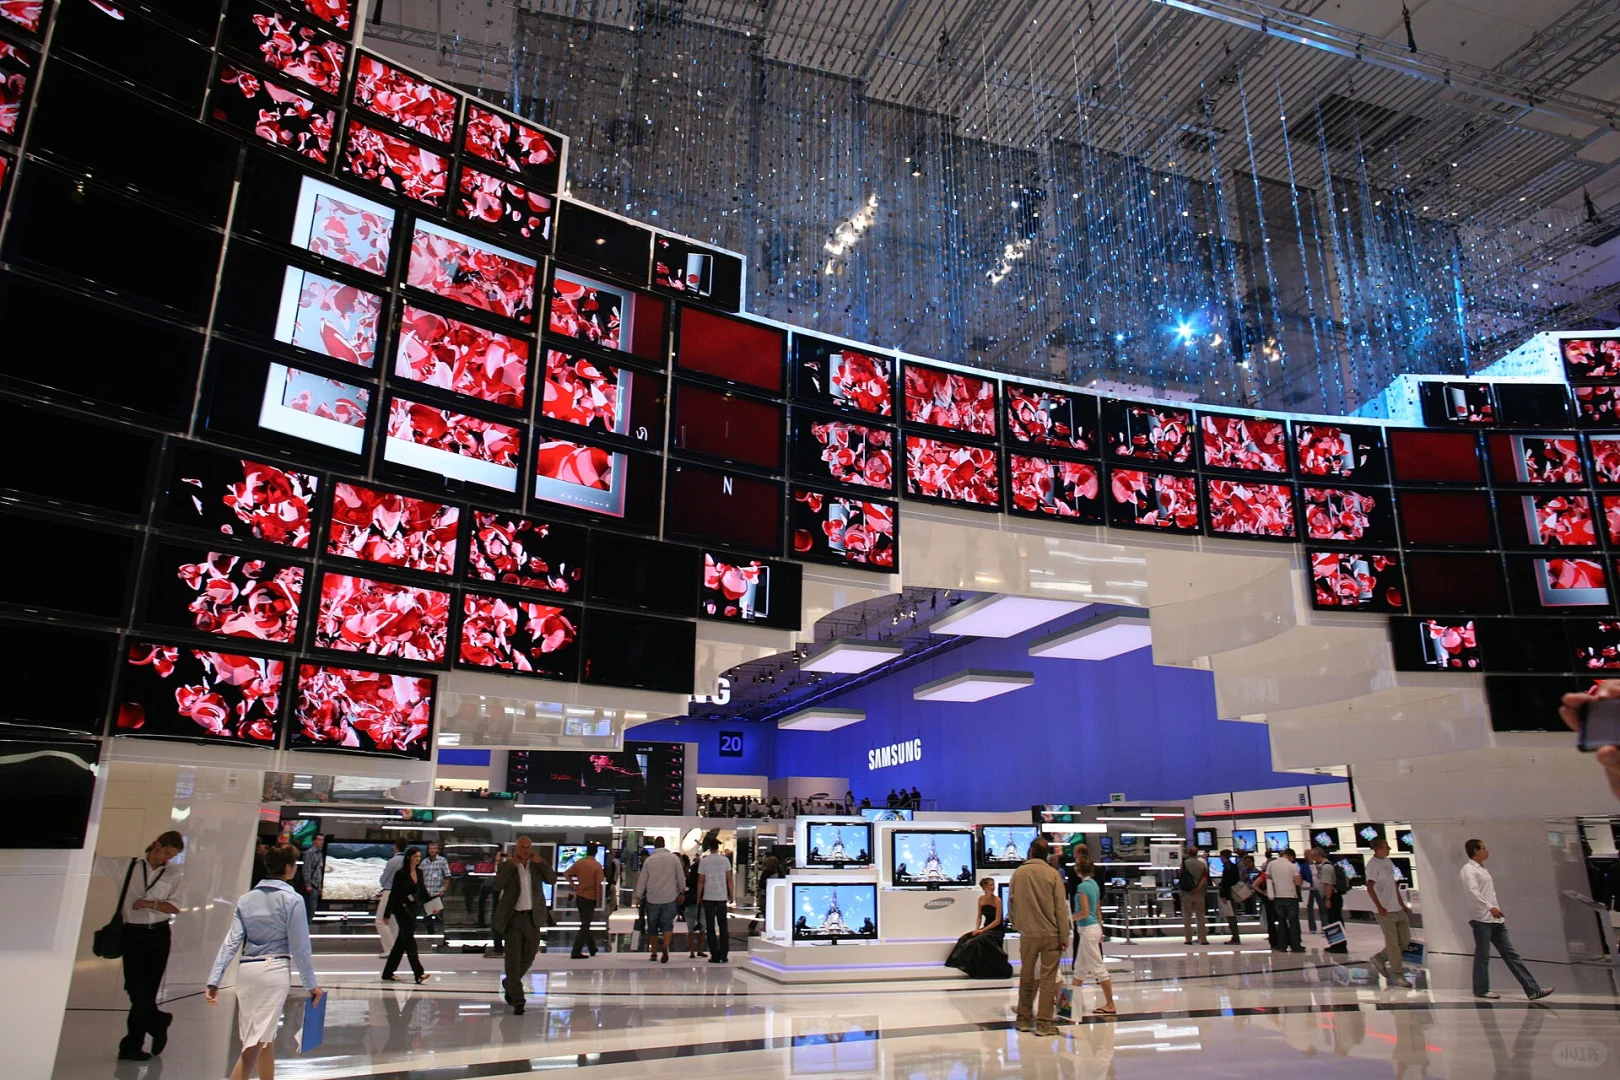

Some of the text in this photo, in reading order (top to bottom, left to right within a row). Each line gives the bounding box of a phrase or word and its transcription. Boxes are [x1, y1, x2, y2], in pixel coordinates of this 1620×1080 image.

[723, 476, 732, 495] N
[721, 736, 741, 752] 20
[868, 738, 922, 771] SAMSUNG
